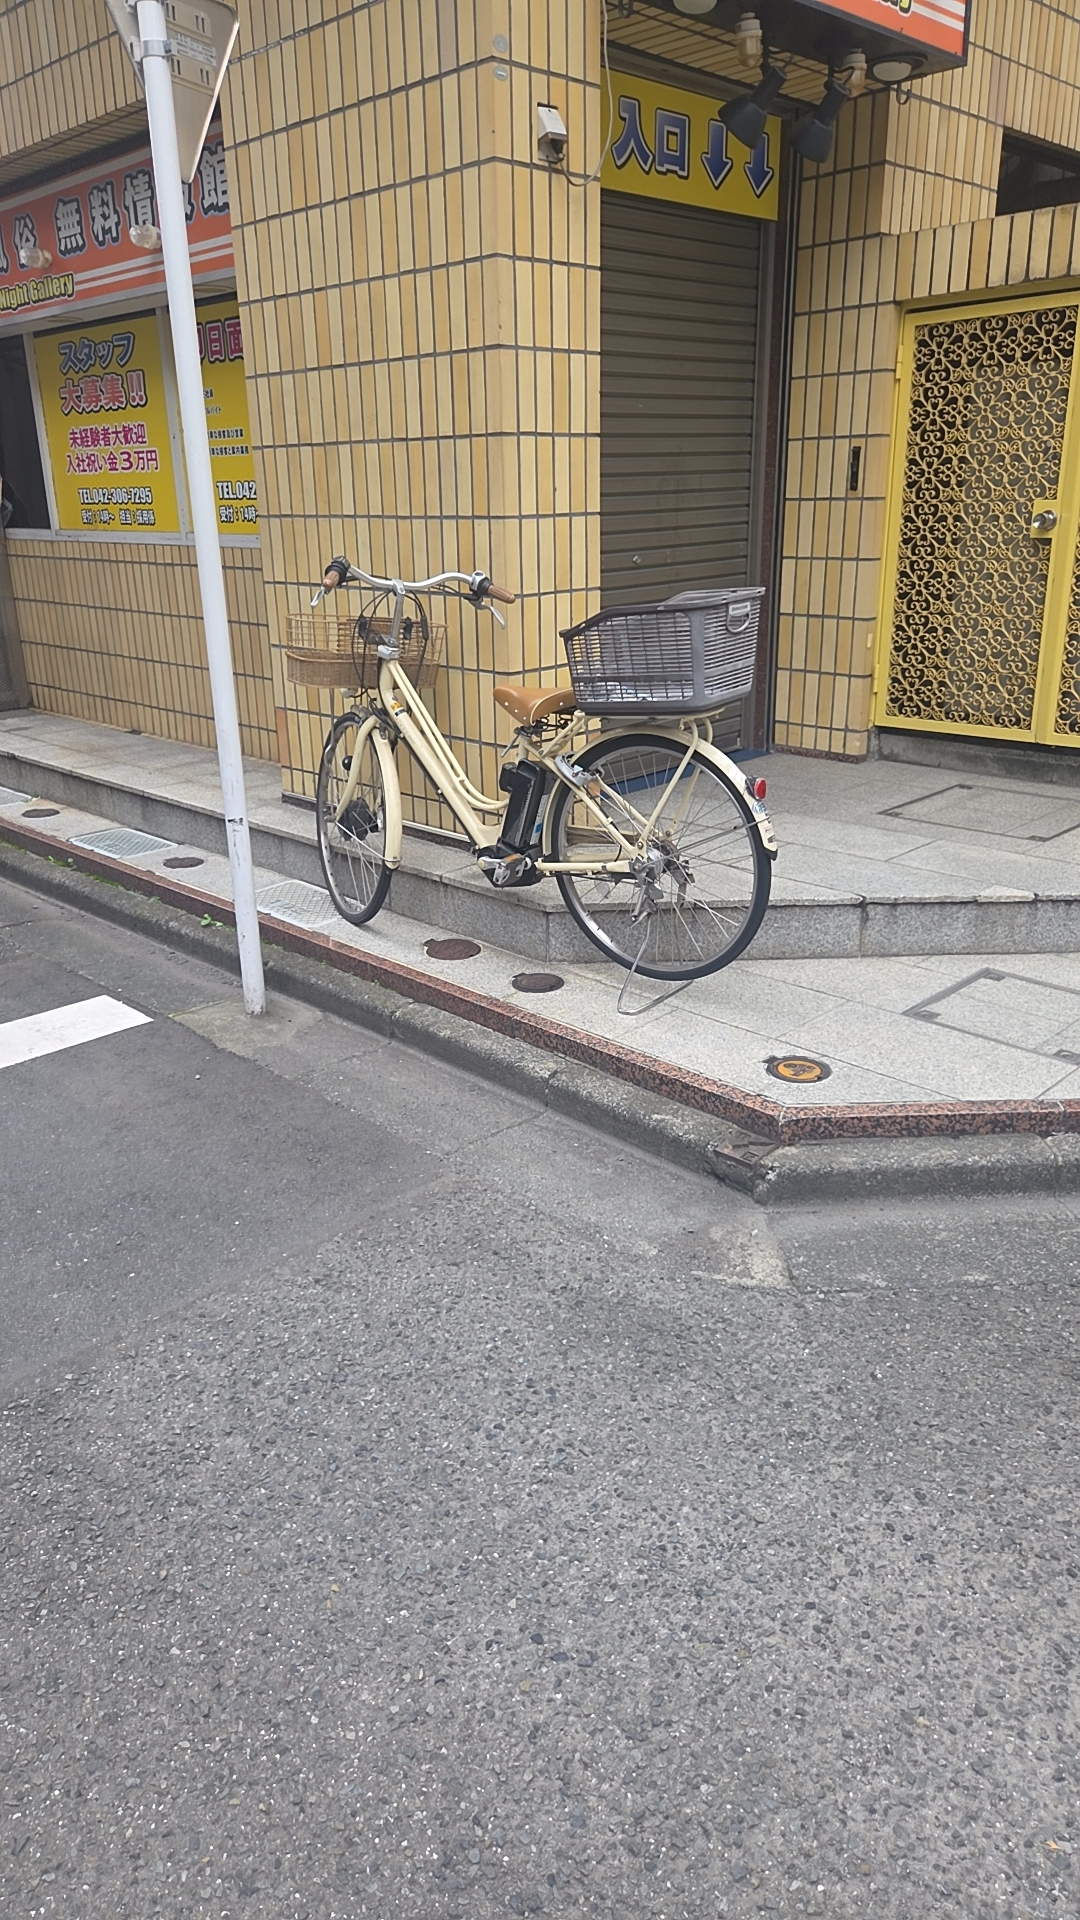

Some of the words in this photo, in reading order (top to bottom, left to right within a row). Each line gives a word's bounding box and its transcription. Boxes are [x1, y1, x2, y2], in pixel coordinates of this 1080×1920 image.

[611, 95, 690, 180] 入口
[54, 139, 230, 257] 無料情館
[0, 284, 30, 311] Night
[29, 272, 75, 304] Gallery
[58, 332, 135, 375] スタッフ
[69, 423, 147, 449] 未経験者大歓迎
[66, 449, 159, 474] 入社祝い金3万円
[77, 486, 153, 505] TEL.042-306-7295
